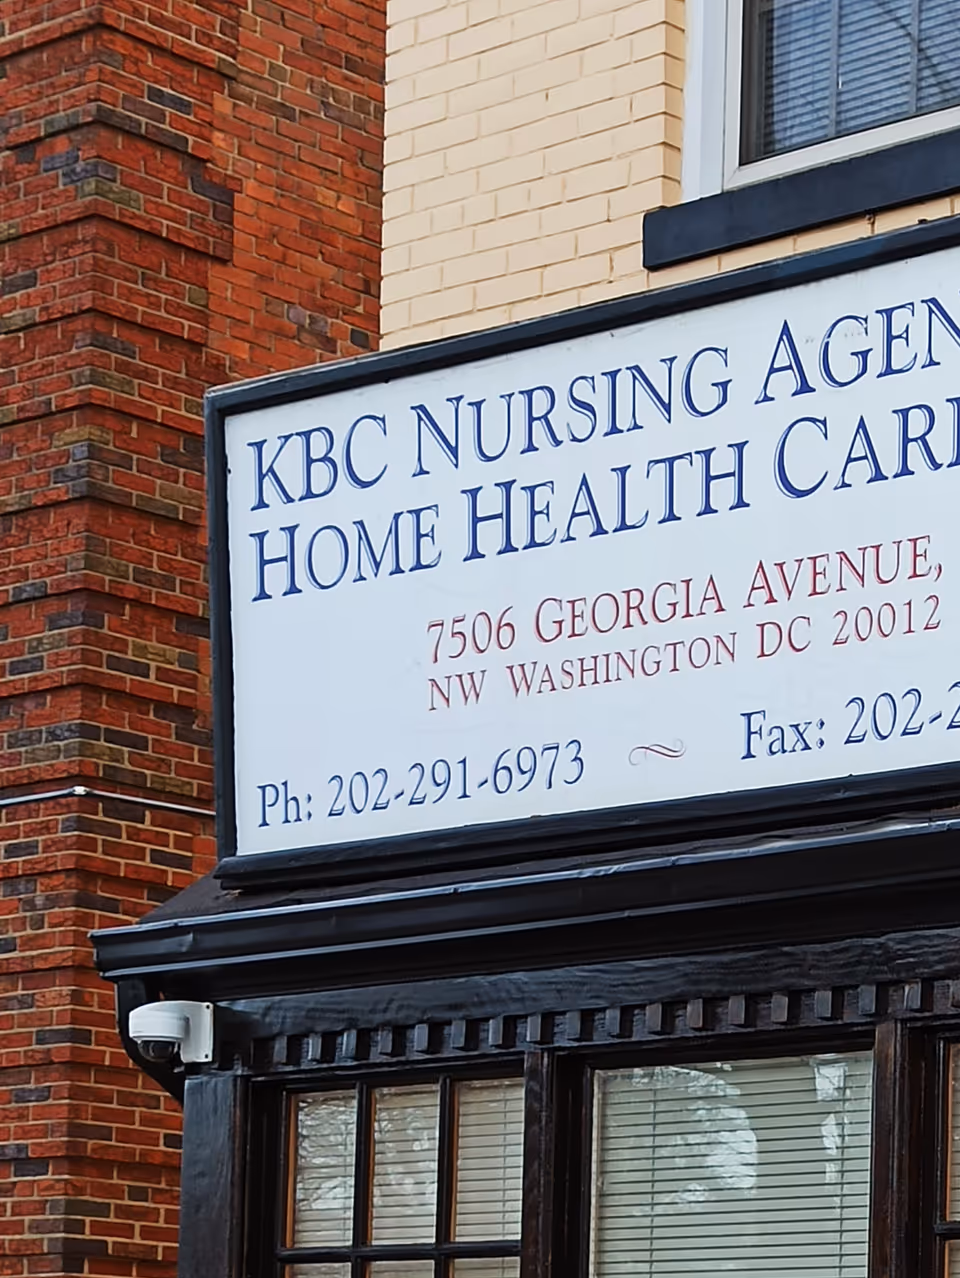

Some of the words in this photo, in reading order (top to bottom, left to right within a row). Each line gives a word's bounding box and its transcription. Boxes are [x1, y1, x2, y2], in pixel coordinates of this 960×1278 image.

[246, 413, 389, 512] KBC
[409, 346, 733, 479] NURSING
[247, 503, 443, 603] HOME
[459, 439, 752, 563] HEALTH
[426, 605, 516, 665] 7506
[534, 573, 727, 644] GEORGIA
[742, 534, 943, 609] AVENUE,
[427, 669, 488, 712] NW
[505, 631, 738, 698] WASHINGTON
[755, 615, 812, 659] DC
[831, 594, 942, 646] 20012
[256, 779, 313, 828] Ph:
[326, 738, 585, 818] 202-291-6973
[739, 709, 826, 761] Fax:
